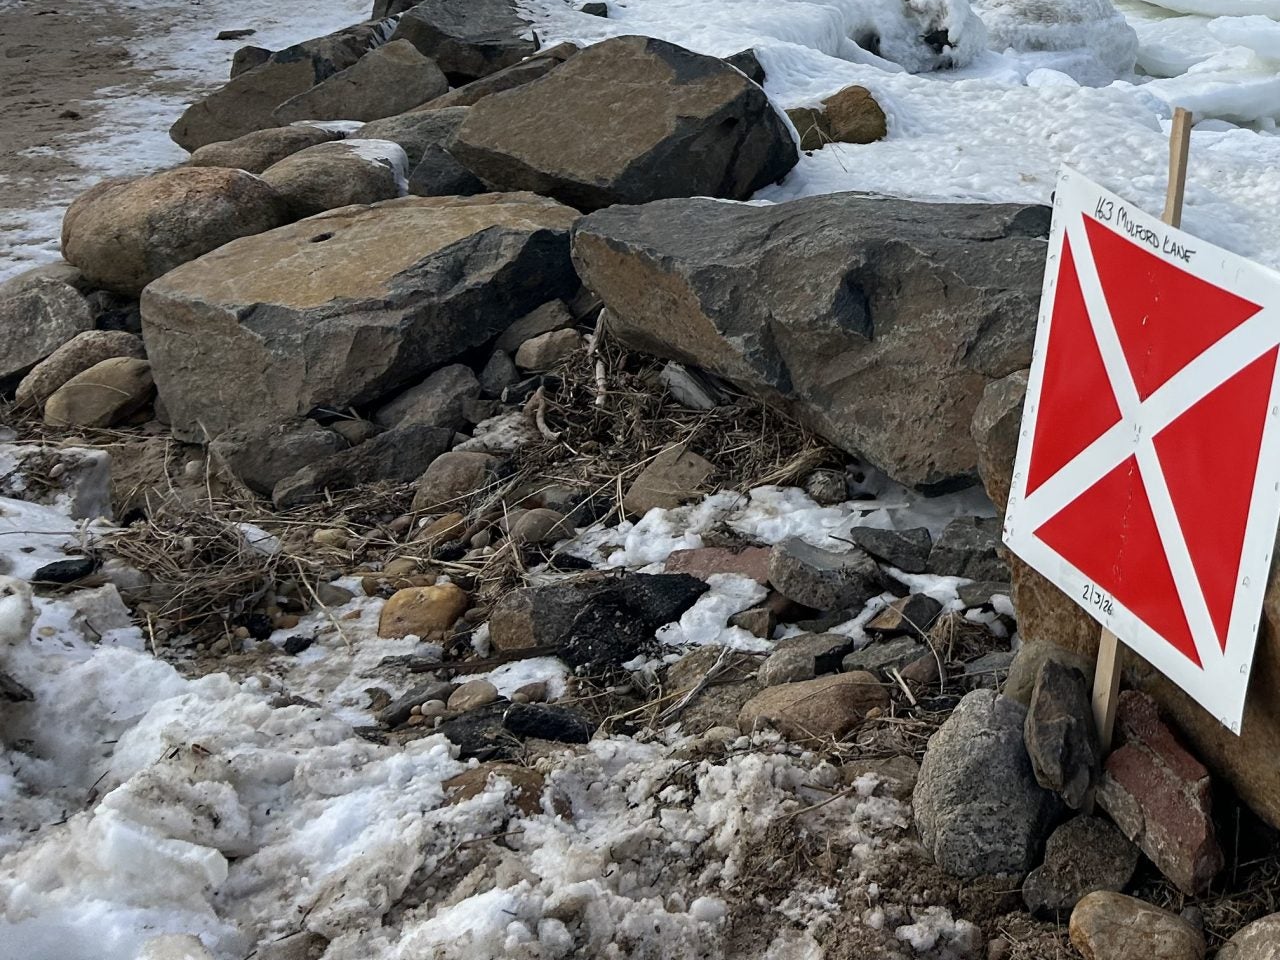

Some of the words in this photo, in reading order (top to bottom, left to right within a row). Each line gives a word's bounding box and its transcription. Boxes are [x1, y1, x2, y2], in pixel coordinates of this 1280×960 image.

[1094, 195, 1114, 221] 163
[1116, 206, 1160, 249] MULFORD
[1163, 235, 1197, 263] LANE
[1082, 584, 1113, 616] 2/3/26
